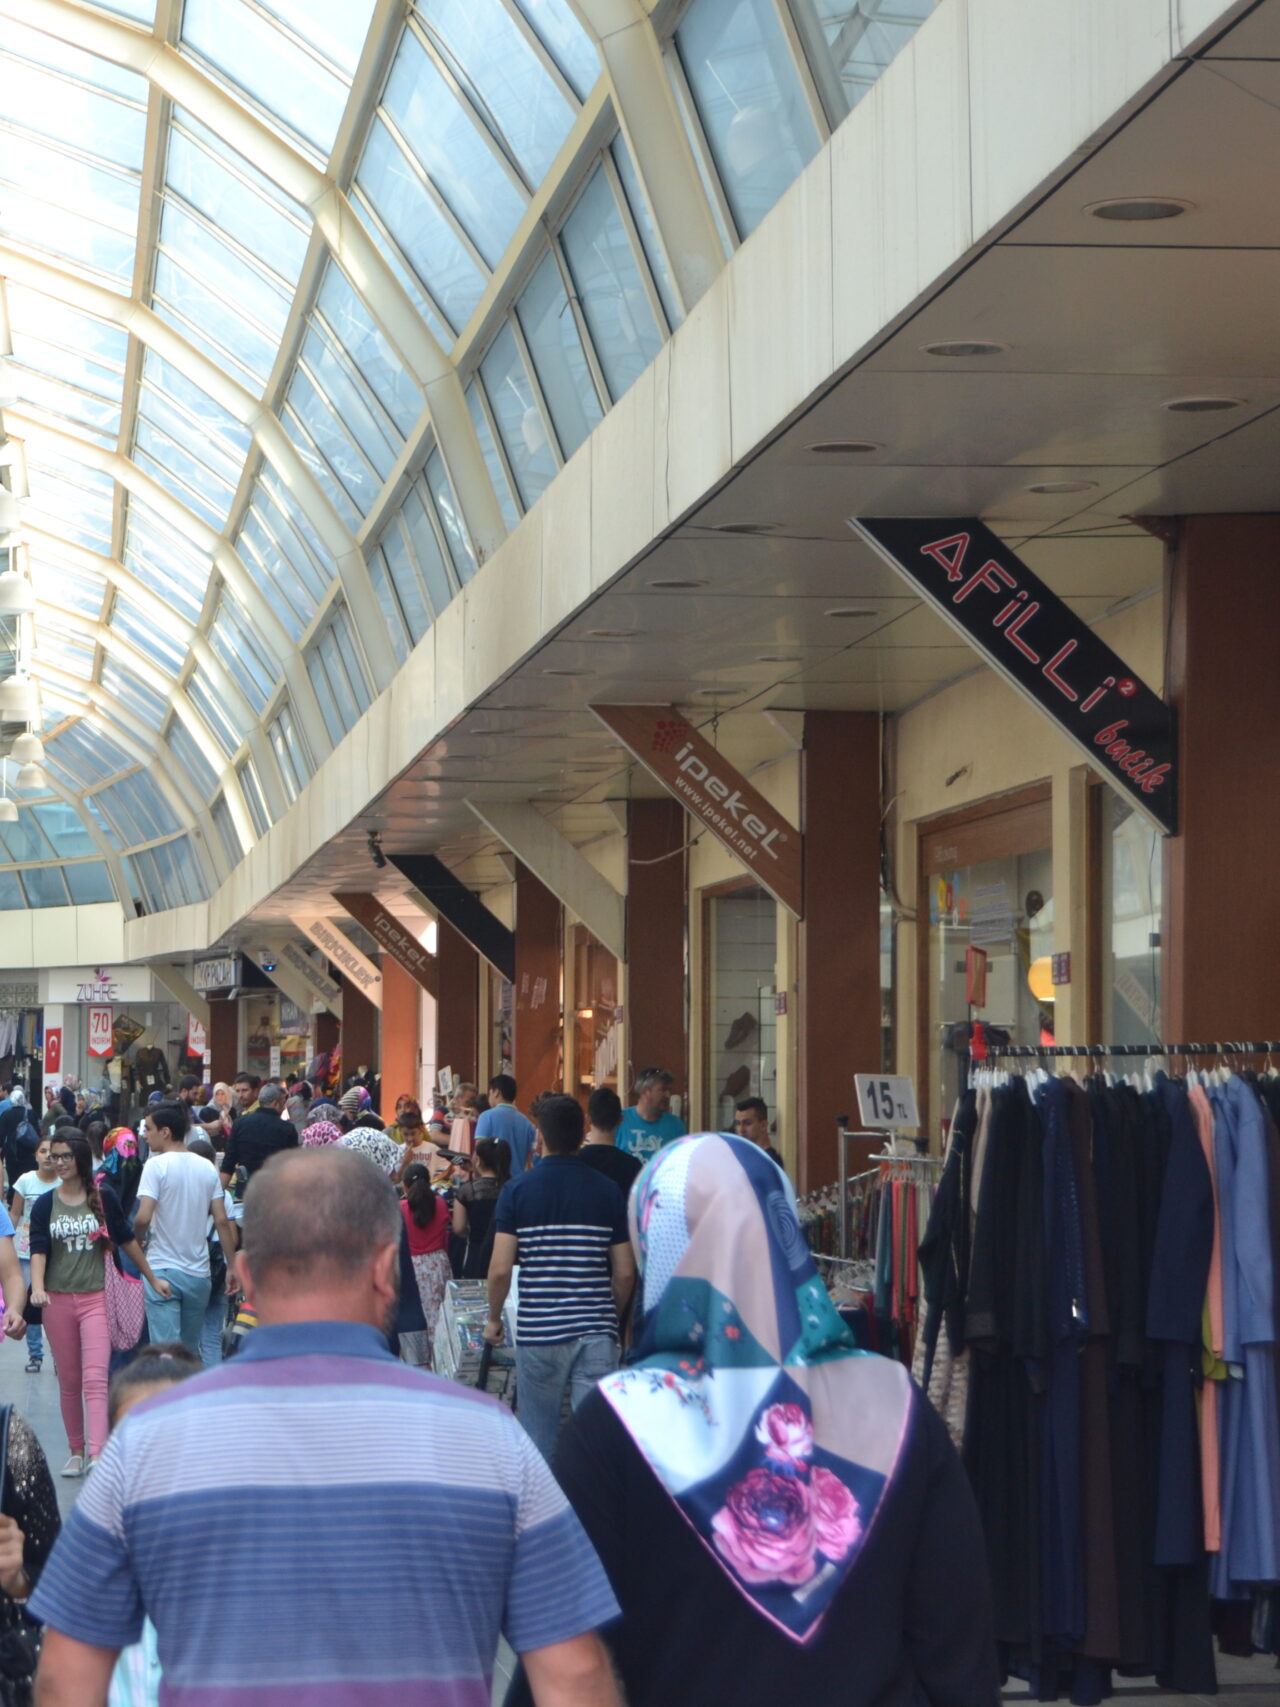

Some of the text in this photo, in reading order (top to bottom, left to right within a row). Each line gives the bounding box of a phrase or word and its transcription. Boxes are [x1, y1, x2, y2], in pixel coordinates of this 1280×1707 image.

[1094, 720, 1171, 793] butik
[674, 776, 758, 860] www.ipekel.net
[867, 1081, 894, 1120] 15
[62, 1234, 94, 1253] TEE
